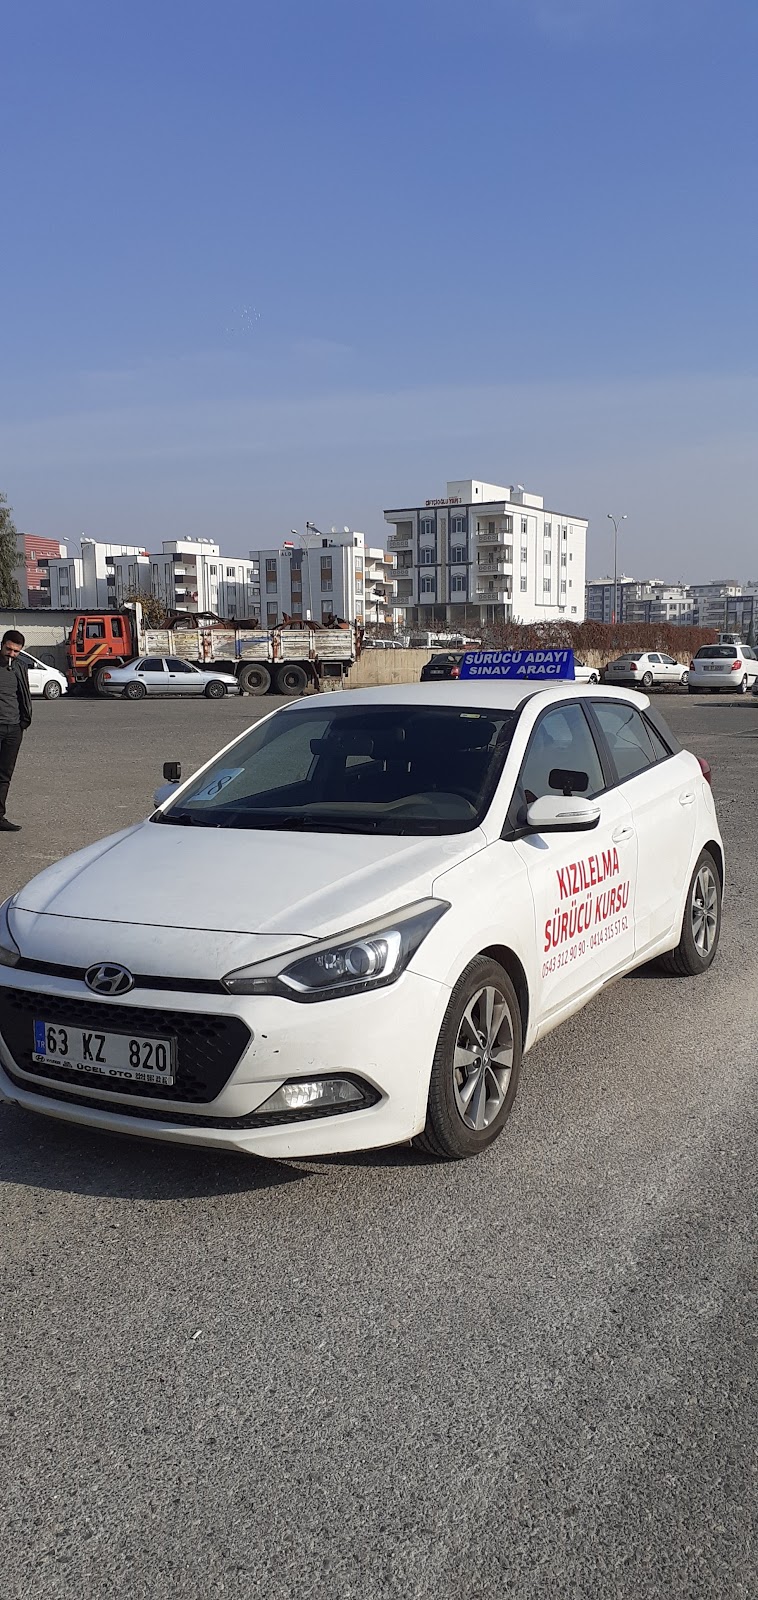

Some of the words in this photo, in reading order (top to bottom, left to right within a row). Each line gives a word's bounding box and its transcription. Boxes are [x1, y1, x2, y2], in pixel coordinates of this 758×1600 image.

[465, 651, 522, 665] SÜRÜCÜ
[525, 651, 568, 663] ADAYI
[469, 666, 511, 675] SINAV
[516, 665, 561, 674] ARACI
[556, 847, 620, 900] KIZILELMA
[544, 892, 593, 953] SÜRÜCÜ
[594, 881, 630, 924] KURSU
[541, 957, 556, 979] 0543
[557, 950, 568, 969] 312
[569, 944, 577, 961] 90
[578, 940, 585, 956] 90
[590, 930, 603, 949] 0414
[604, 923, 614, 941] 315
[615, 919, 620, 935] 57
[621, 916, 629, 931] 62
[37, 1040, 45, 1048] TR
[47, 1027, 69, 1055] 63
[82, 1032, 106, 1063] KZ
[129, 1039, 167, 1072] 820
[76, 1063, 105, 1075] ÜCEL
[108, 1069, 132, 1079] OTO
